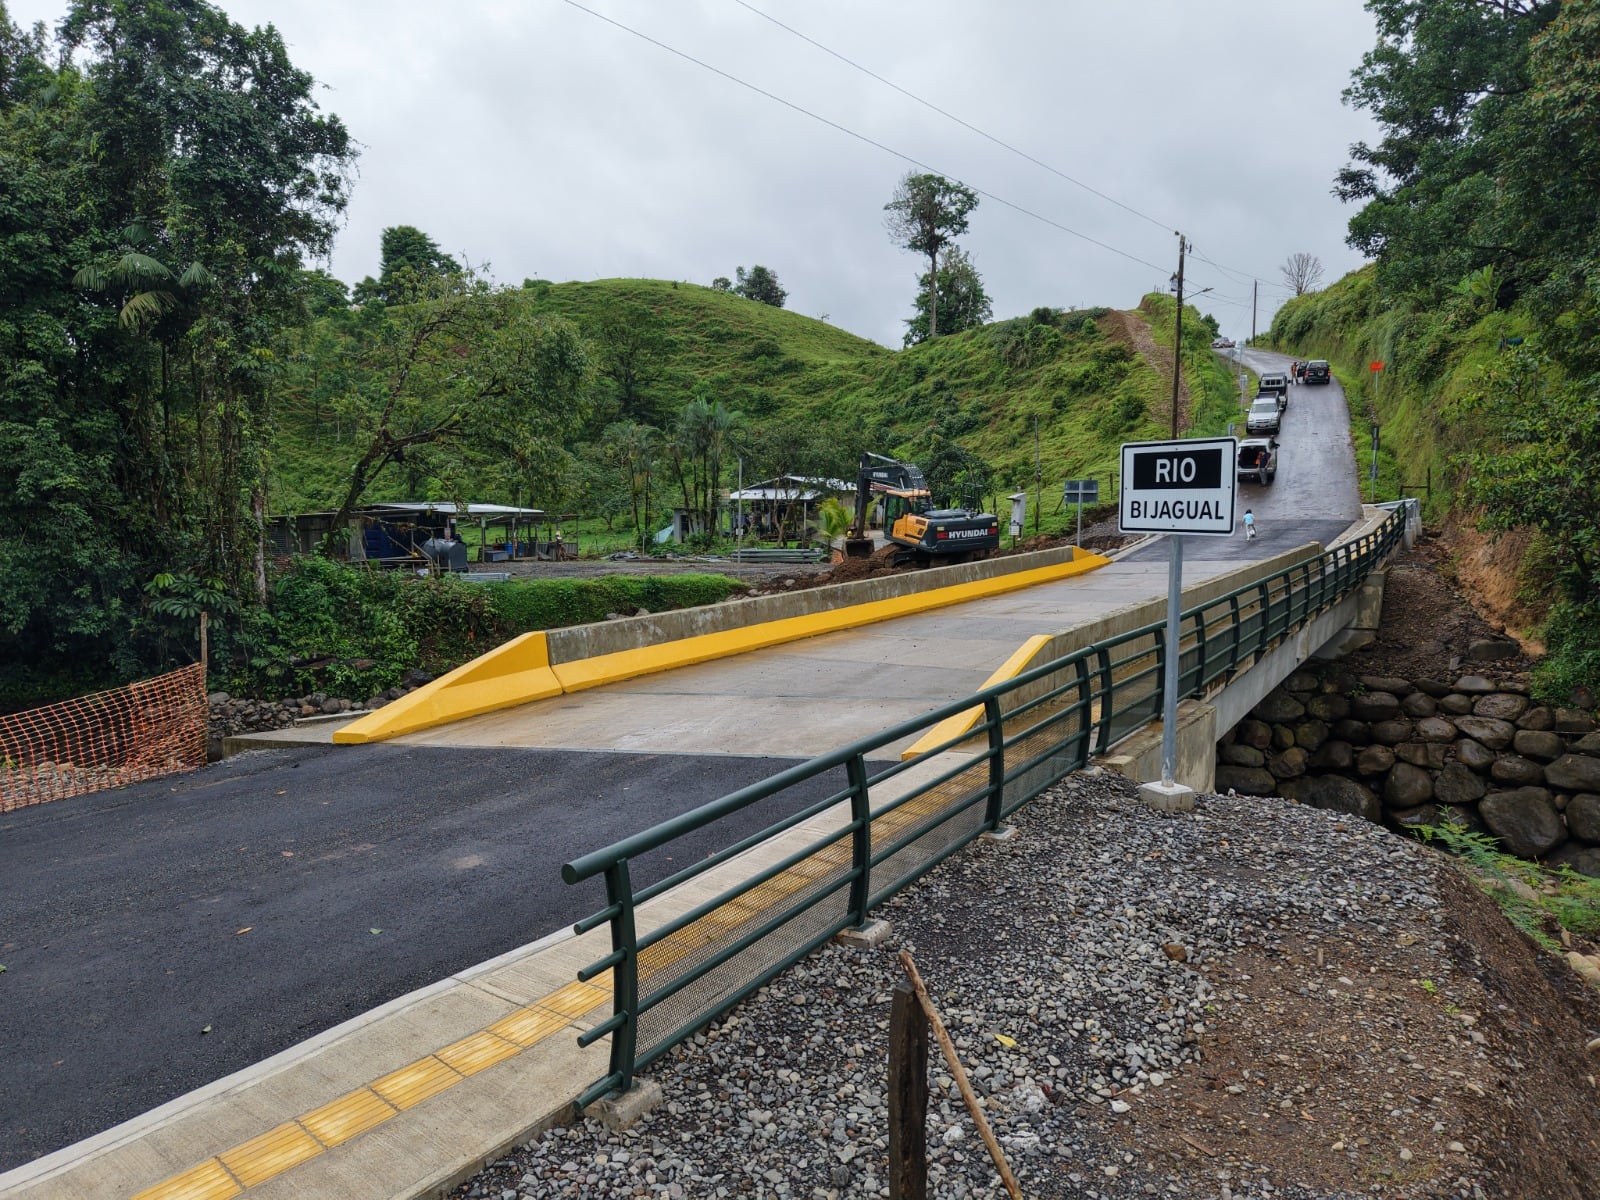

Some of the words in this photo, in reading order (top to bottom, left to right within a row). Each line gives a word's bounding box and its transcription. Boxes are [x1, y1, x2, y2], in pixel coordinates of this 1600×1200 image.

[1155, 457, 1197, 483] RIO
[1130, 500, 1225, 520] BIJAGUAL
[948, 529, 988, 539] HYUNDAI
